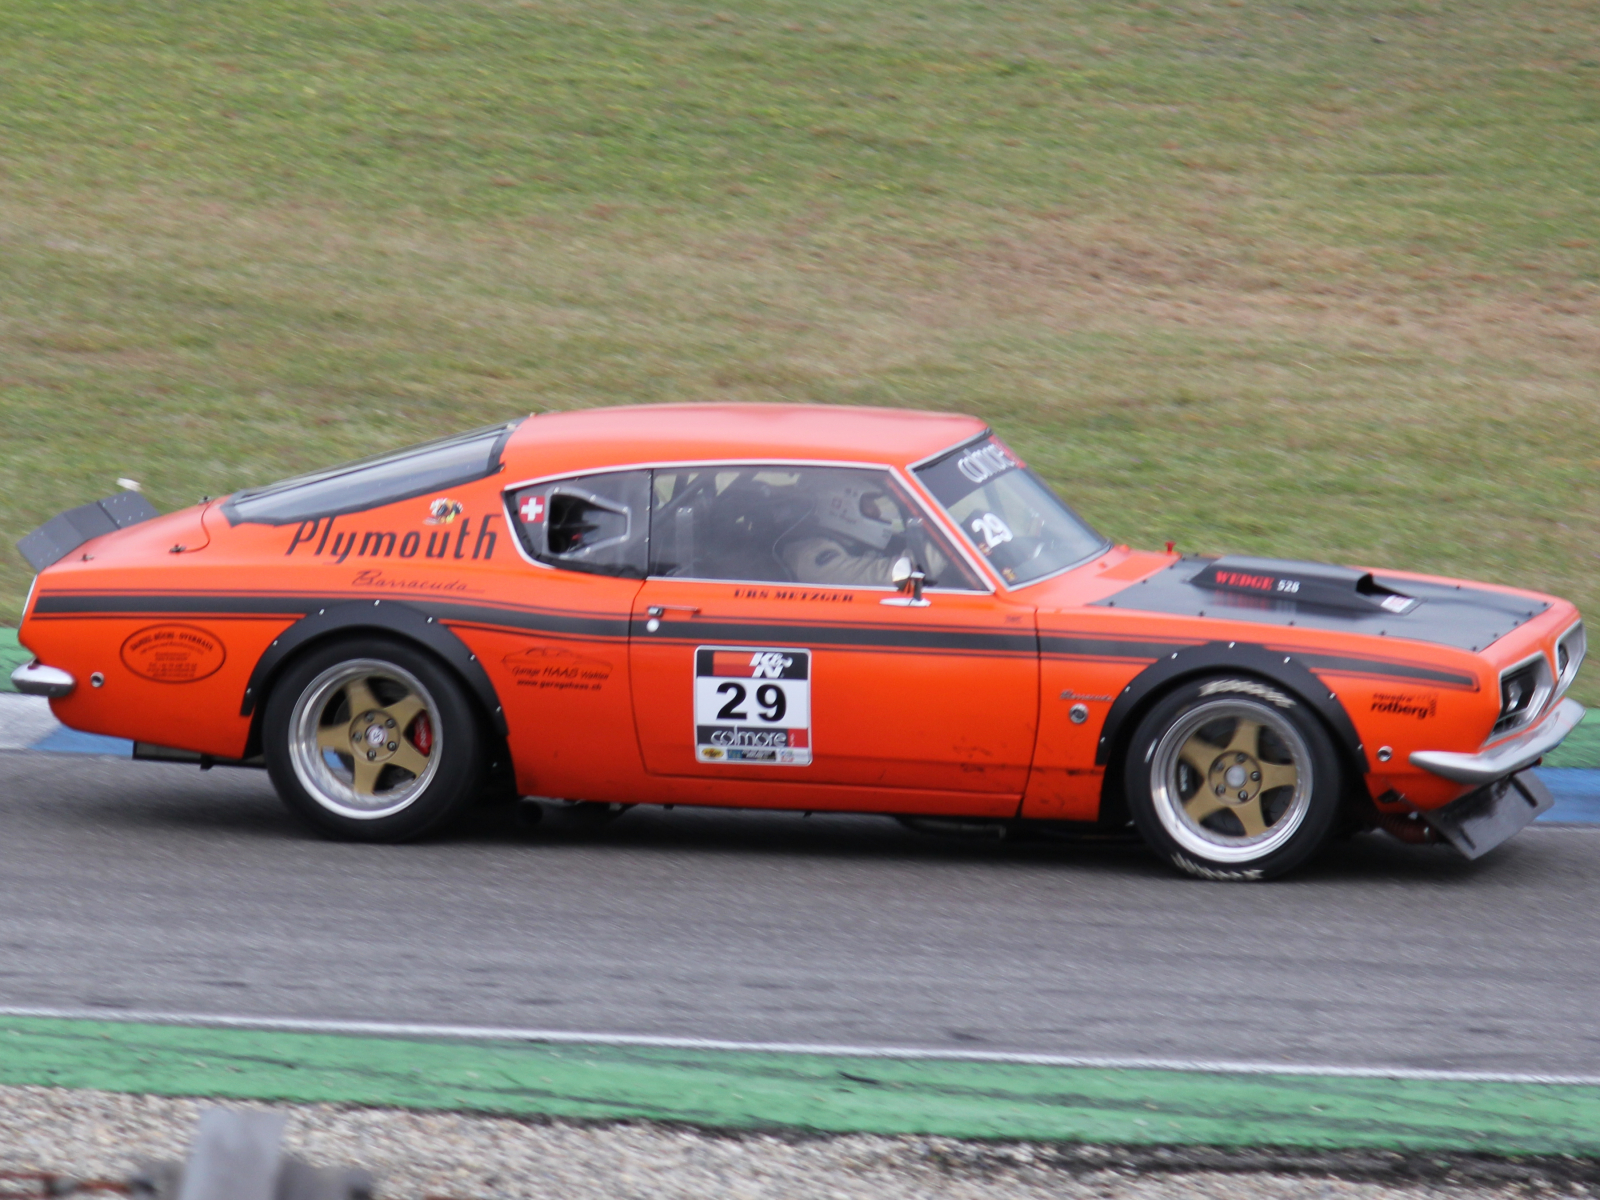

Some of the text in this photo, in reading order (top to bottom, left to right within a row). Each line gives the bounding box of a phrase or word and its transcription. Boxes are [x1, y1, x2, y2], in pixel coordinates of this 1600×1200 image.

[284, 513, 502, 566] Plymouth
[971, 512, 1013, 549] 29
[351, 569, 485, 594] Barracuda
[1214, 570, 1299, 594] WEDGE 528
[773, 590, 853, 603] METZGER
[715, 682, 787, 722] 29
[1370, 702, 1428, 721] rotberg
[710, 724, 787, 747] colmore
